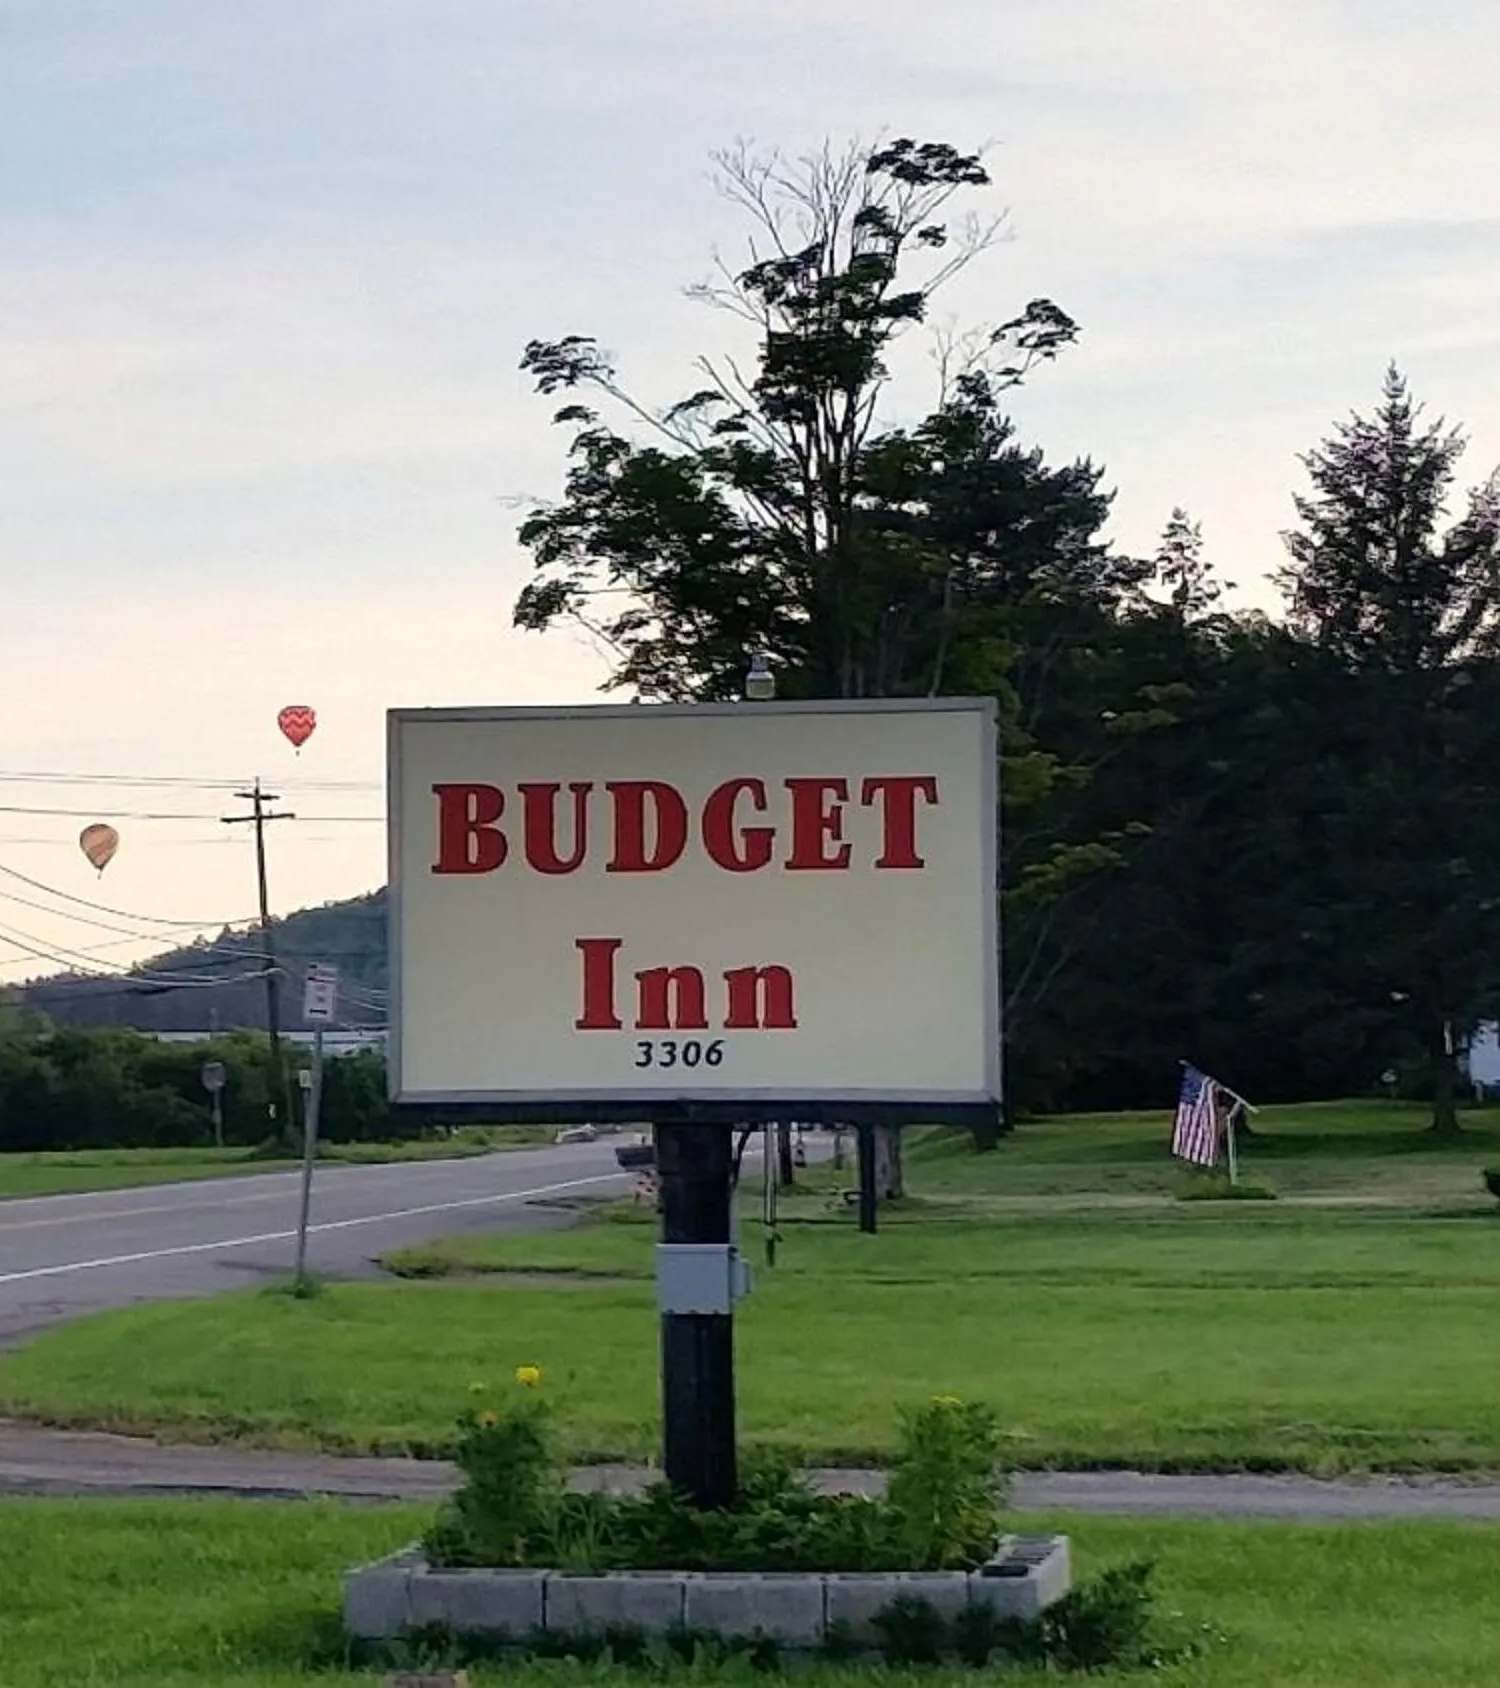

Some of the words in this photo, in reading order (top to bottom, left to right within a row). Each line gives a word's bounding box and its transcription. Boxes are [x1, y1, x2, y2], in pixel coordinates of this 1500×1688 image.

[431, 776, 939, 875] BUDGET
[575, 938, 798, 1030] Inn
[635, 1040, 726, 1067] 3306
